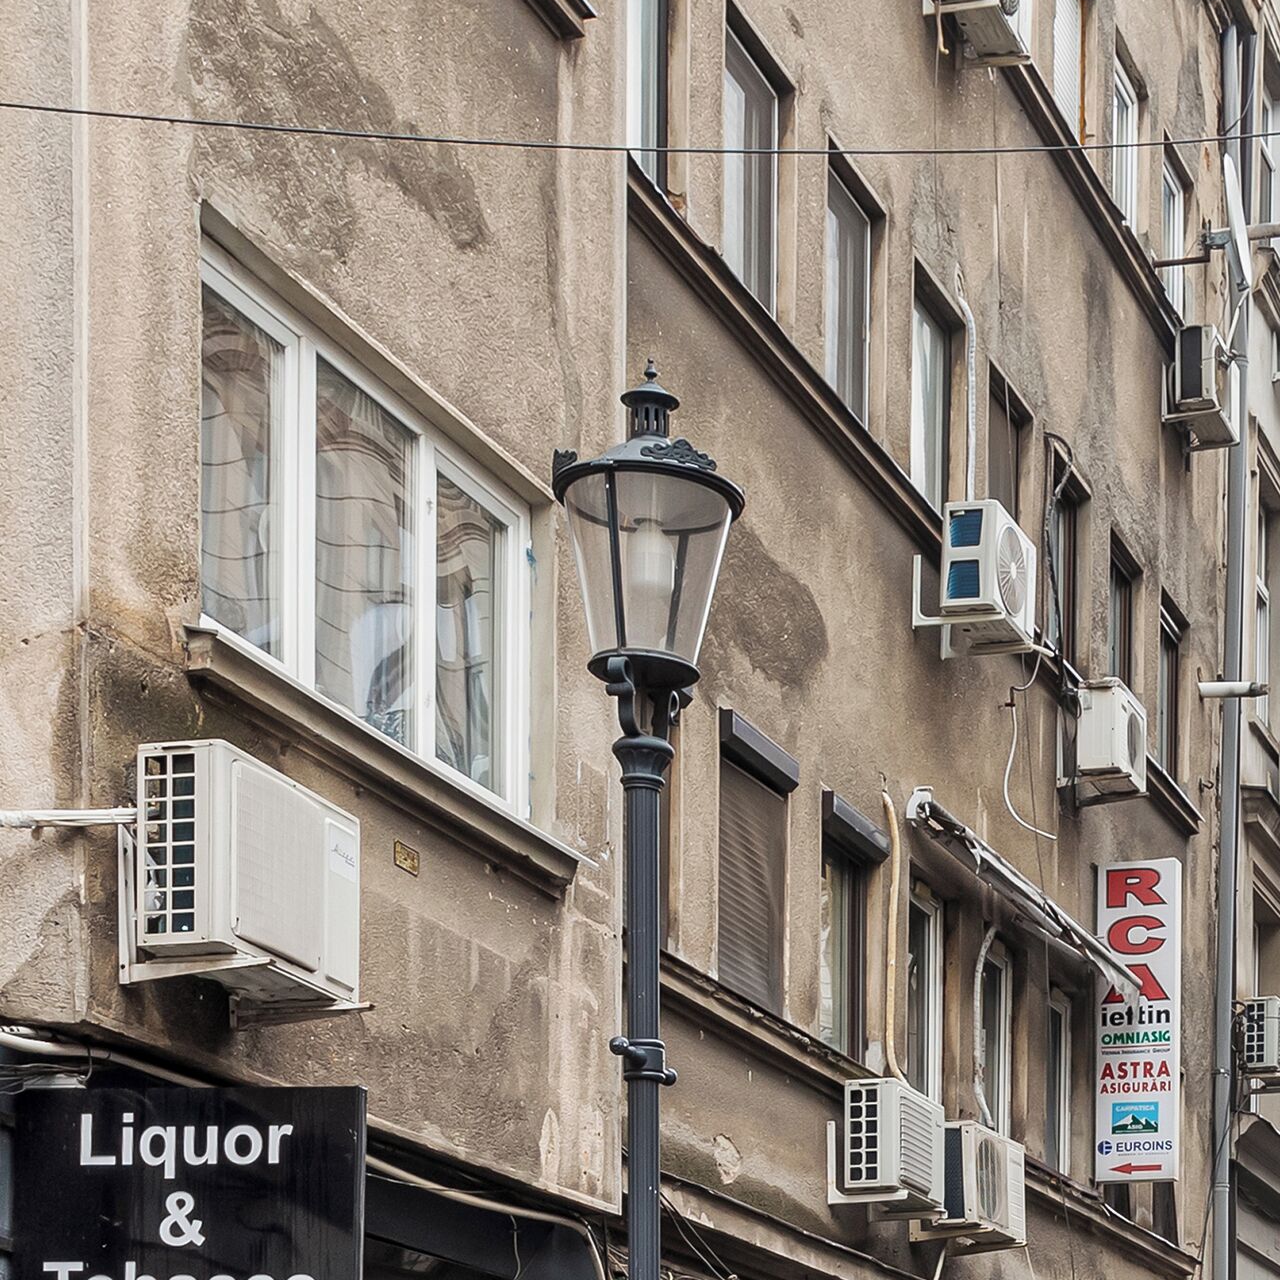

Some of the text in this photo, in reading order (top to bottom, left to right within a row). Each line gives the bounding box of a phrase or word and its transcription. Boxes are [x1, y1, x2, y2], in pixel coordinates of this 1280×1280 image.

[1101, 1030, 1170, 1045] OMNIASIG
[1100, 1060, 1171, 1080] ASTRA
[1100, 1078, 1171, 1094] ASIGURĂRI
[79, 1112, 293, 1180] Liquor
[1116, 1140, 1173, 1152] EUROINS
[158, 1190, 206, 1247] &
